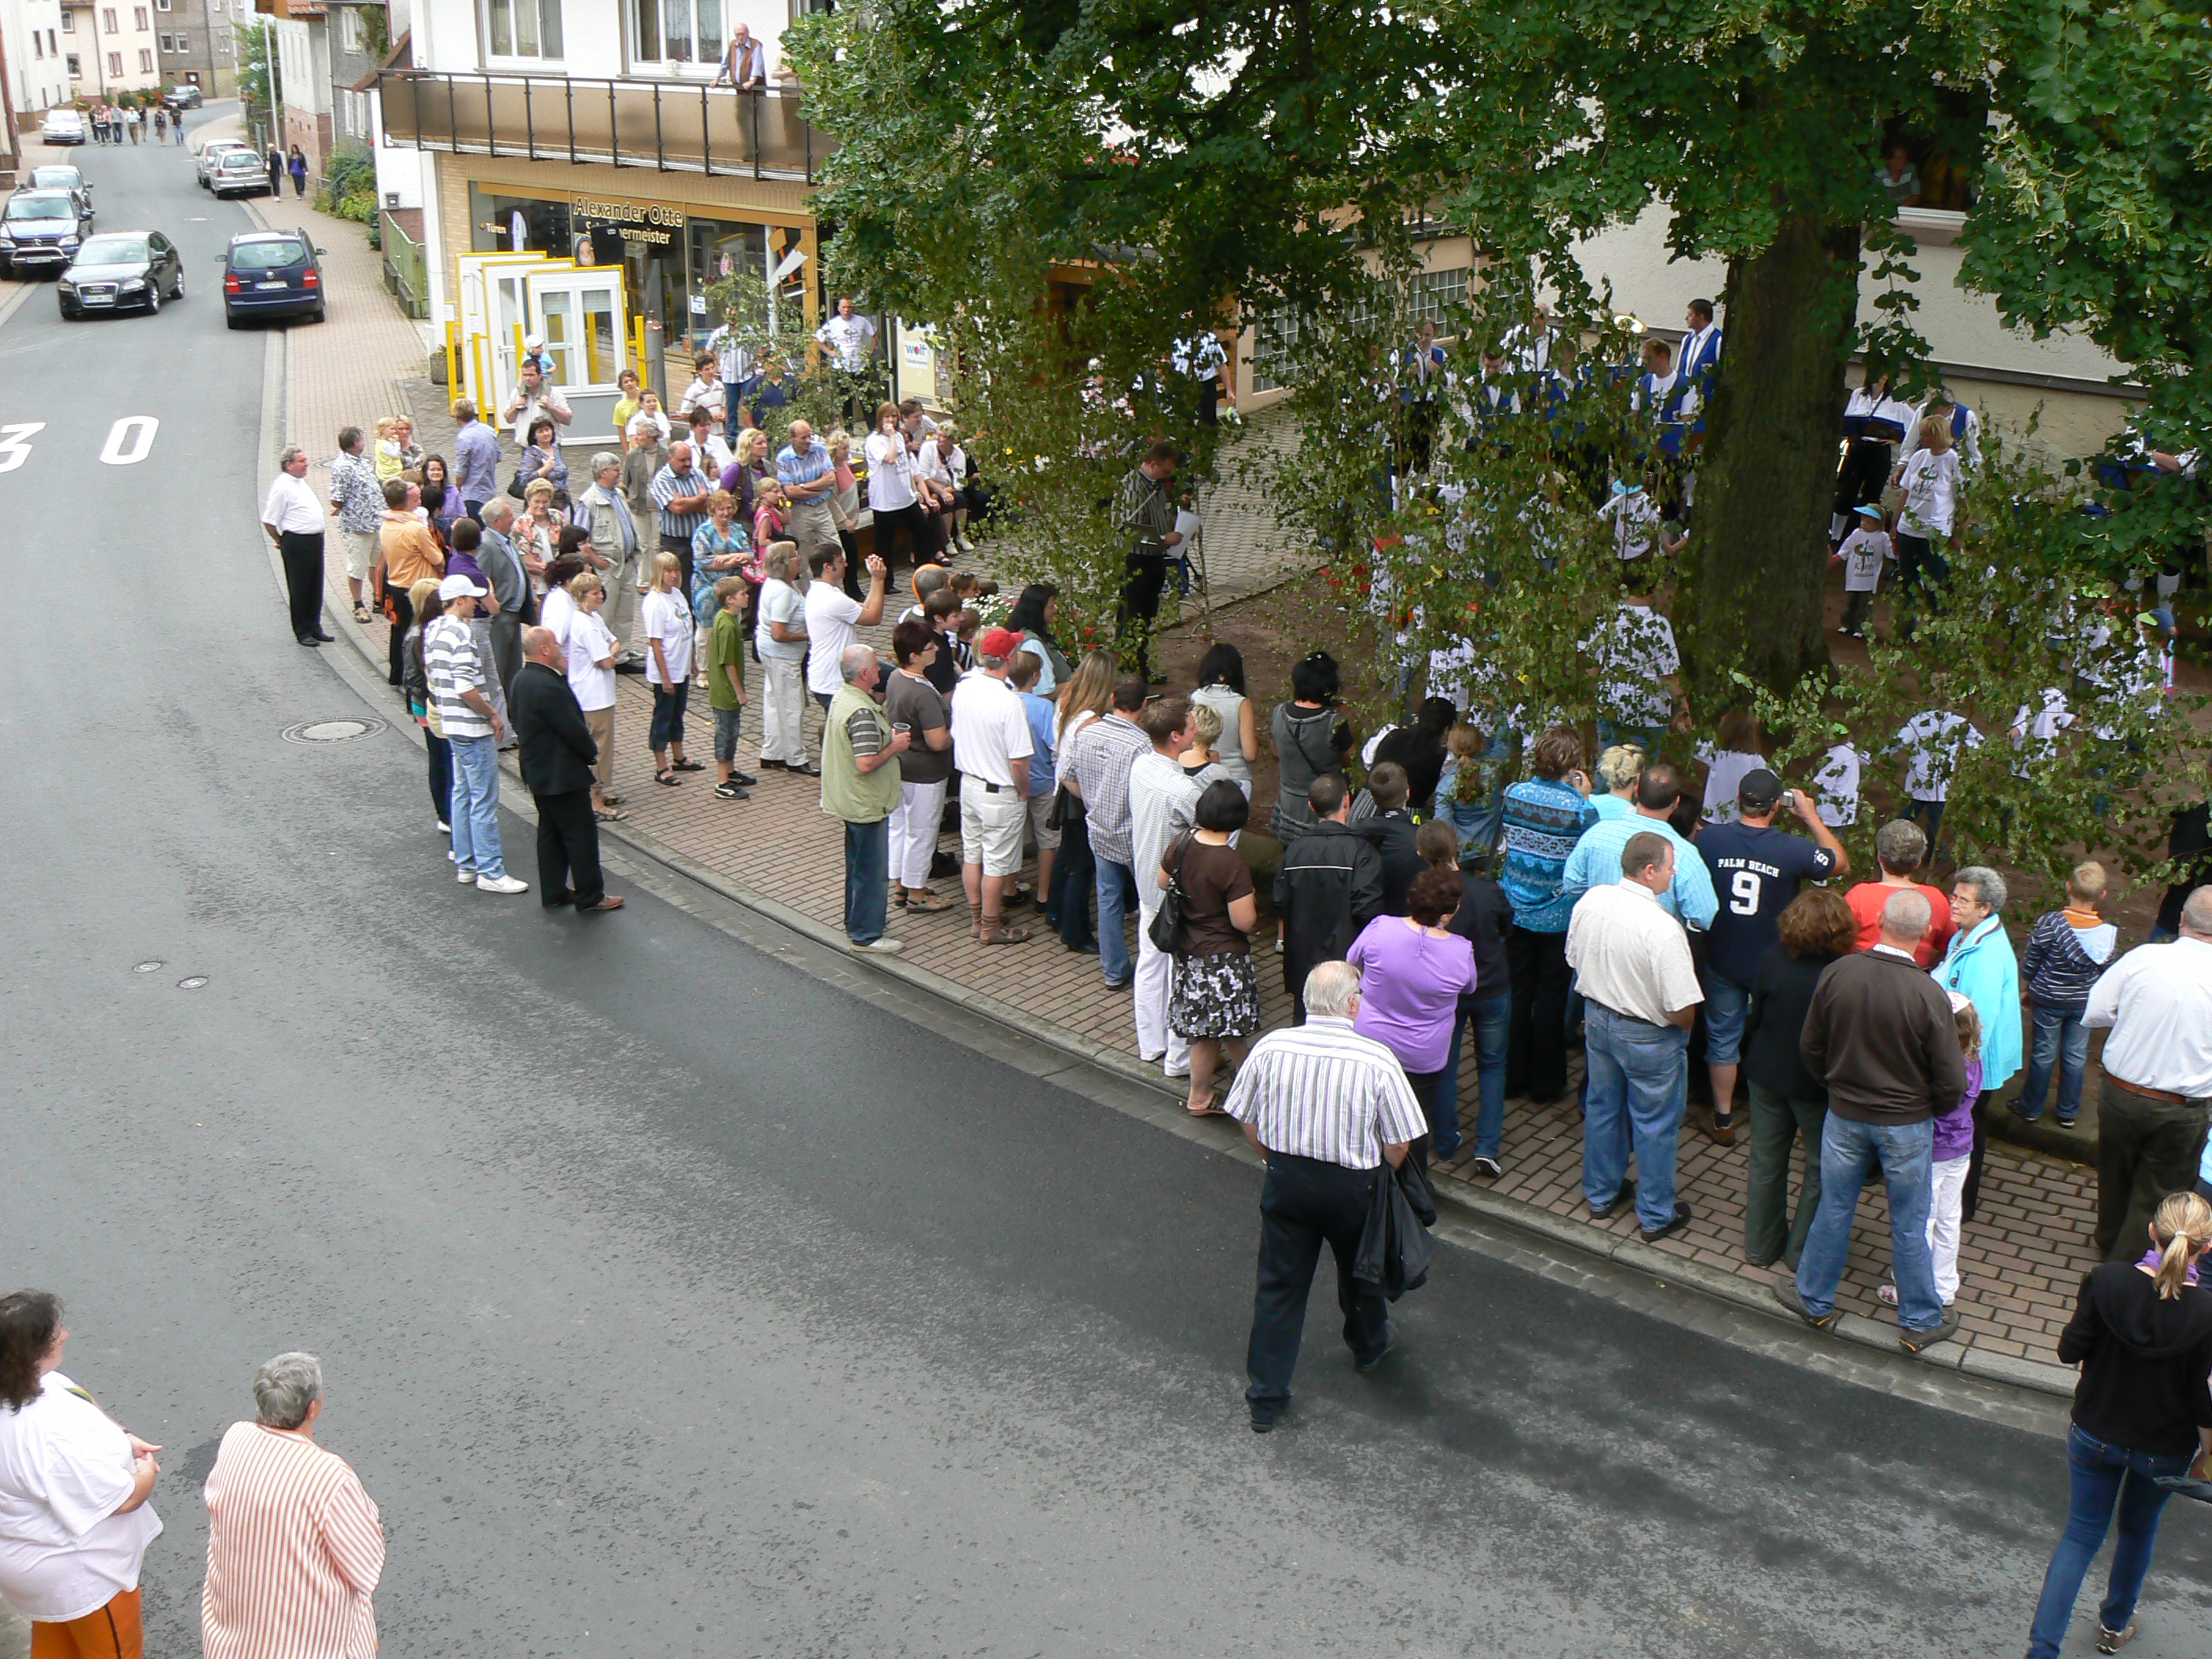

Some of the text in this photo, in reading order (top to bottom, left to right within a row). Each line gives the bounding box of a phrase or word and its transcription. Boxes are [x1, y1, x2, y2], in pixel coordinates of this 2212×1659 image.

[574, 197, 683, 227] Alexander Otte
[1718, 859, 1780, 877] PALM BEACH
[1730, 870, 1761, 915] 9
